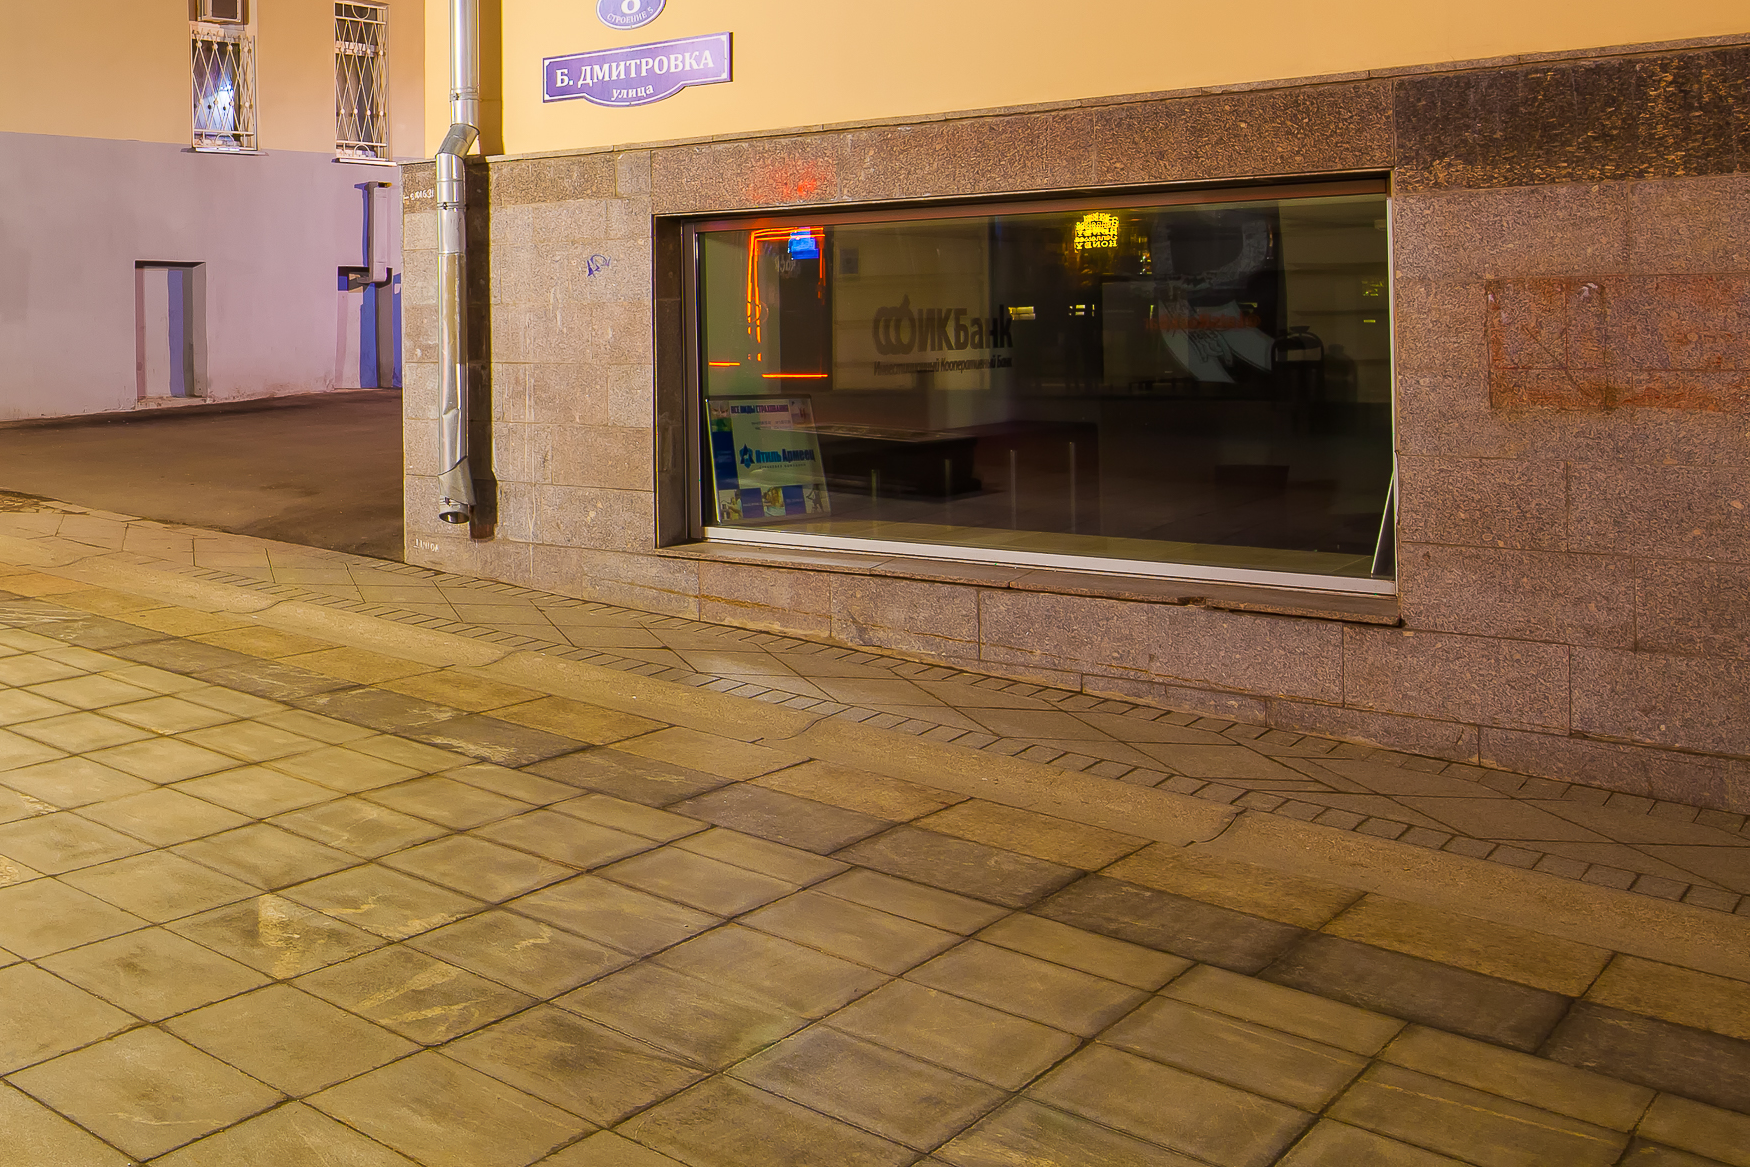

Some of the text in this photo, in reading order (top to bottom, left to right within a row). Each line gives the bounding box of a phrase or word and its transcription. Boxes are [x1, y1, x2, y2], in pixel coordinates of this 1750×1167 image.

[606, 6, 654, 24] СТРОЕНИЕ 5
[555, 49, 715, 89] Б. ДМИТРОВКА
[610, 84, 655, 101] улица
